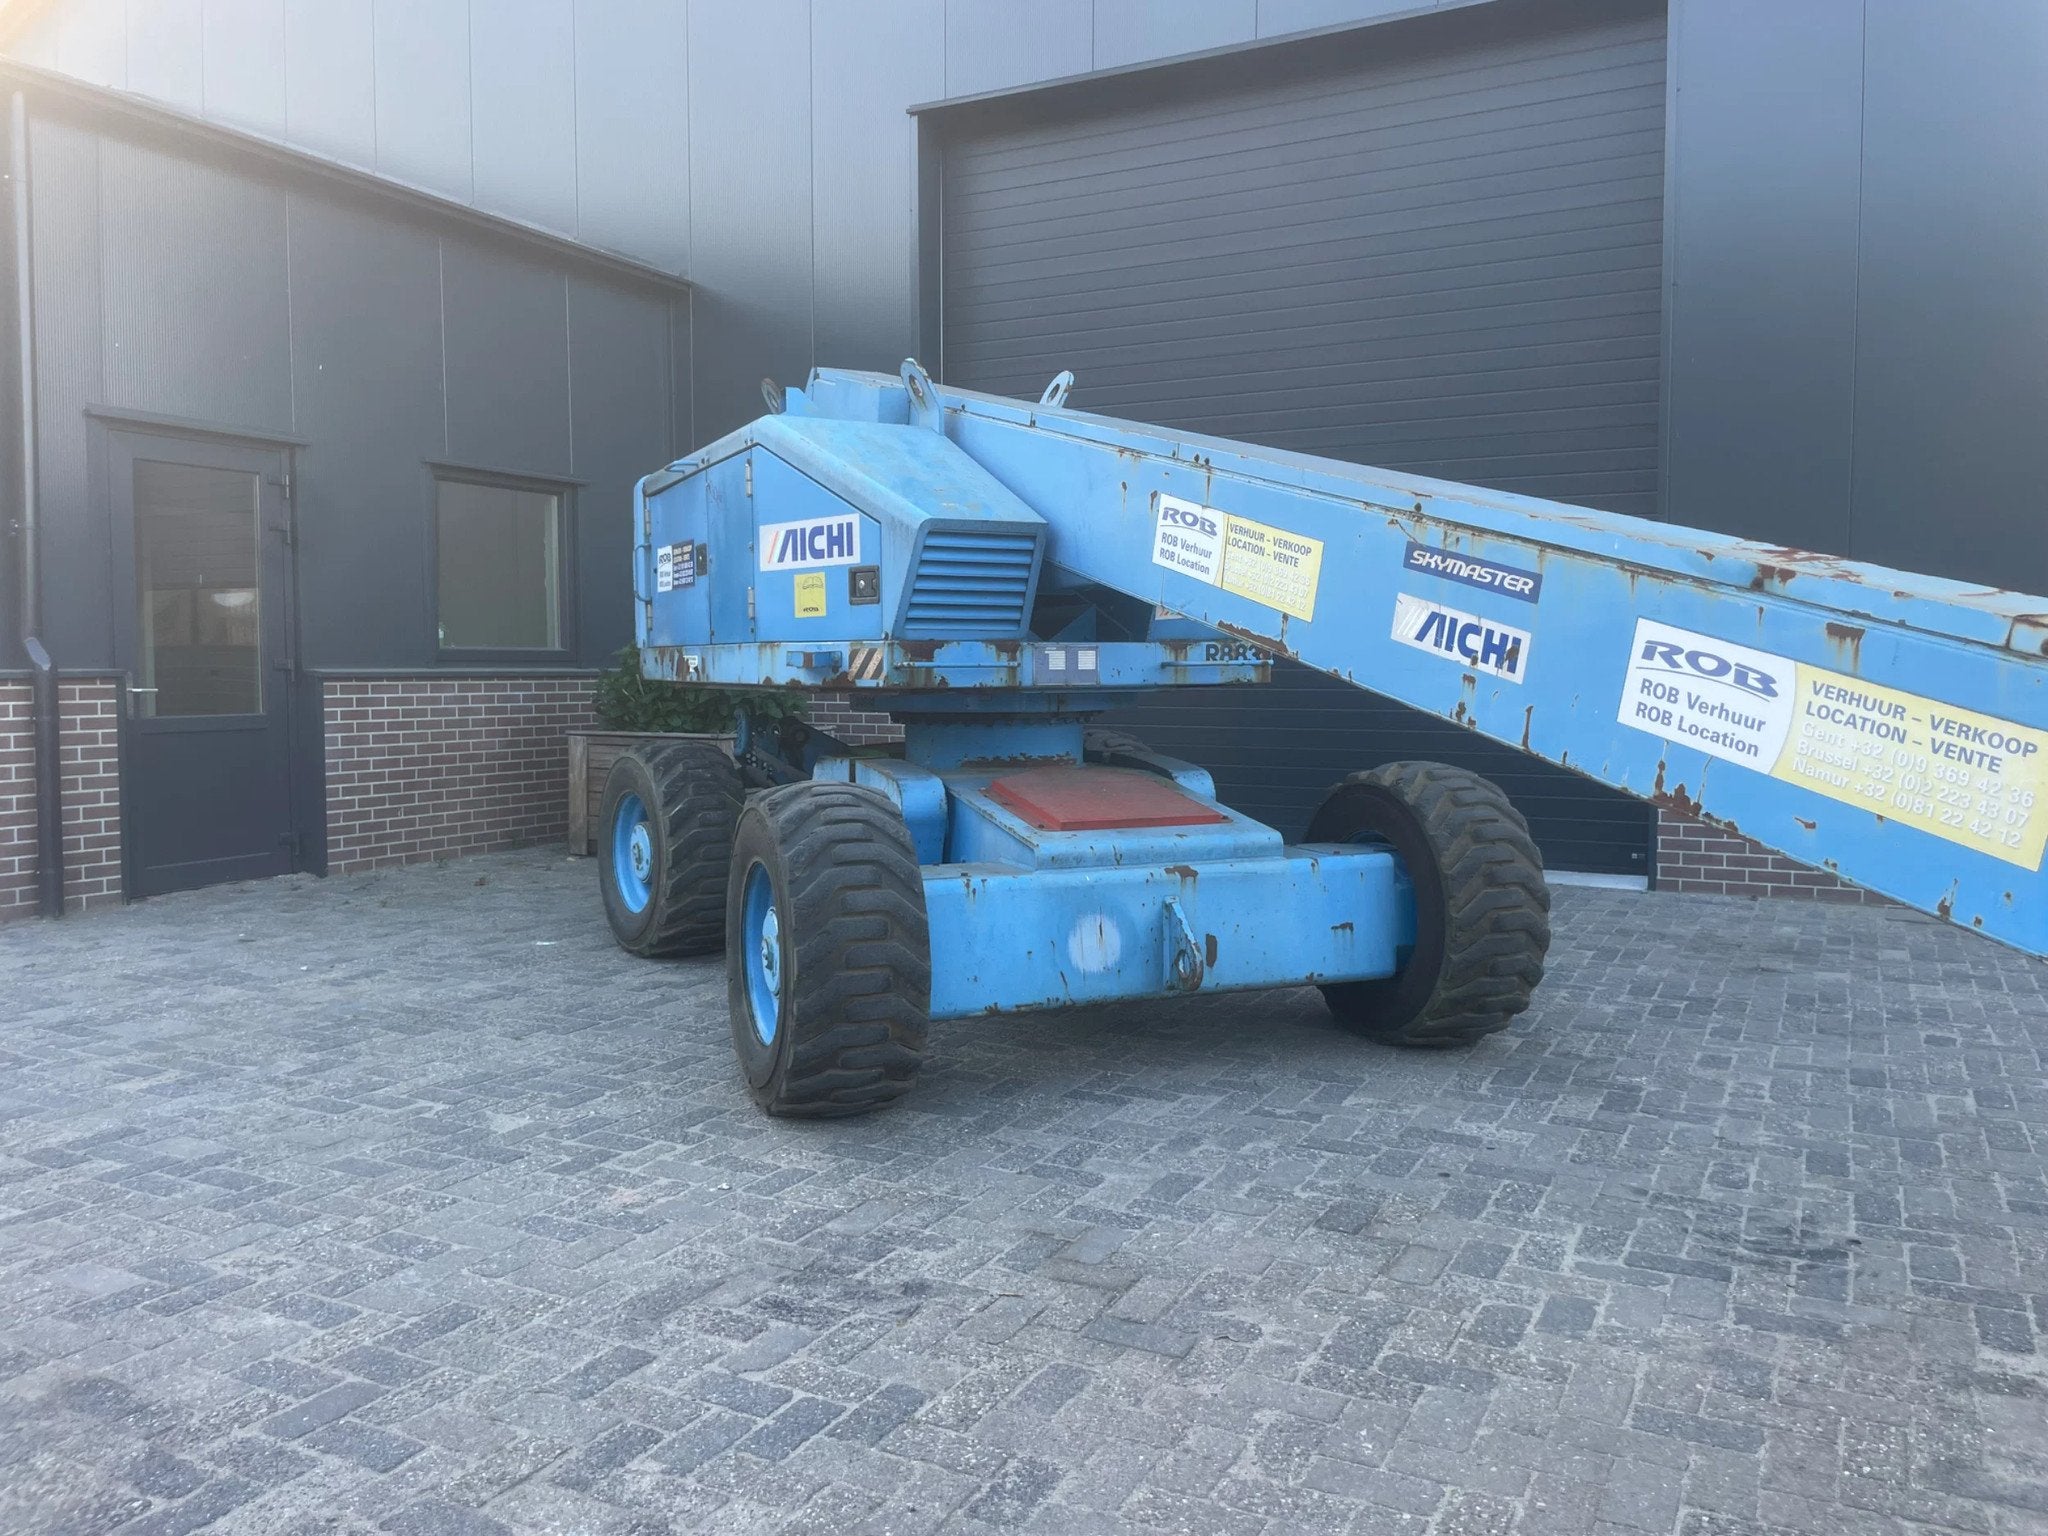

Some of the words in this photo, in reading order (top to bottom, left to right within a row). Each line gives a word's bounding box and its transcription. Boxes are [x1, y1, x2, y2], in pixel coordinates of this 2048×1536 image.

[777, 521, 853, 564] AICHI
[1161, 532, 1178, 548] ROB
[1180, 537, 1212, 559] Verhuur
[1162, 506, 1217, 537] ROB
[1229, 523, 1265, 543] VERHUUR
[1273, 537, 1312, 557] VERKOOP
[1159, 547, 1176, 563] ROB
[1176, 555, 1210, 575] Location
[1227, 537, 1265, 557] LOCATION
[1273, 551, 1299, 568] VENTE
[1410, 550, 1534, 595] SKYMASTER
[1414, 611, 1522, 674] AICHI
[1641, 639, 1779, 698] ROB
[1635, 701, 1673, 727] ROB
[1677, 715, 1760, 758] Location
[1640, 677, 1680, 705] ROB
[1686, 691, 1766, 733] Verhuur
[1811, 680, 1907, 722] VERHUUR
[1929, 714, 2039, 758] VERKOOP
[1802, 721, 1847, 749] Gent
[1850, 740, 1883, 760] +32
[1889, 747, 1927, 773] (0)9
[1933, 763, 1970, 787] 369
[1976, 777, 2002, 796] 42
[2008, 786, 2035, 808] 36
[1805, 700, 1908, 745] LOCATION
[1929, 737, 2003, 774] VENTE
[1792, 758, 1850, 789] Namur
[1854, 782, 1886, 802] +32
[1890, 790, 1935, 818] (0)81
[1940, 807, 1965, 828] 22
[1969, 818, 1993, 838] 42
[2001, 828, 2023, 849] 12
[1795, 739, 1858, 772] Brussel
[1861, 763, 1893, 783] +32
[1898, 770, 1931, 797] (0)2
[1937, 786, 1971, 809] 223
[1977, 799, 2000, 819] 43
[2004, 807, 2030, 828] 07
